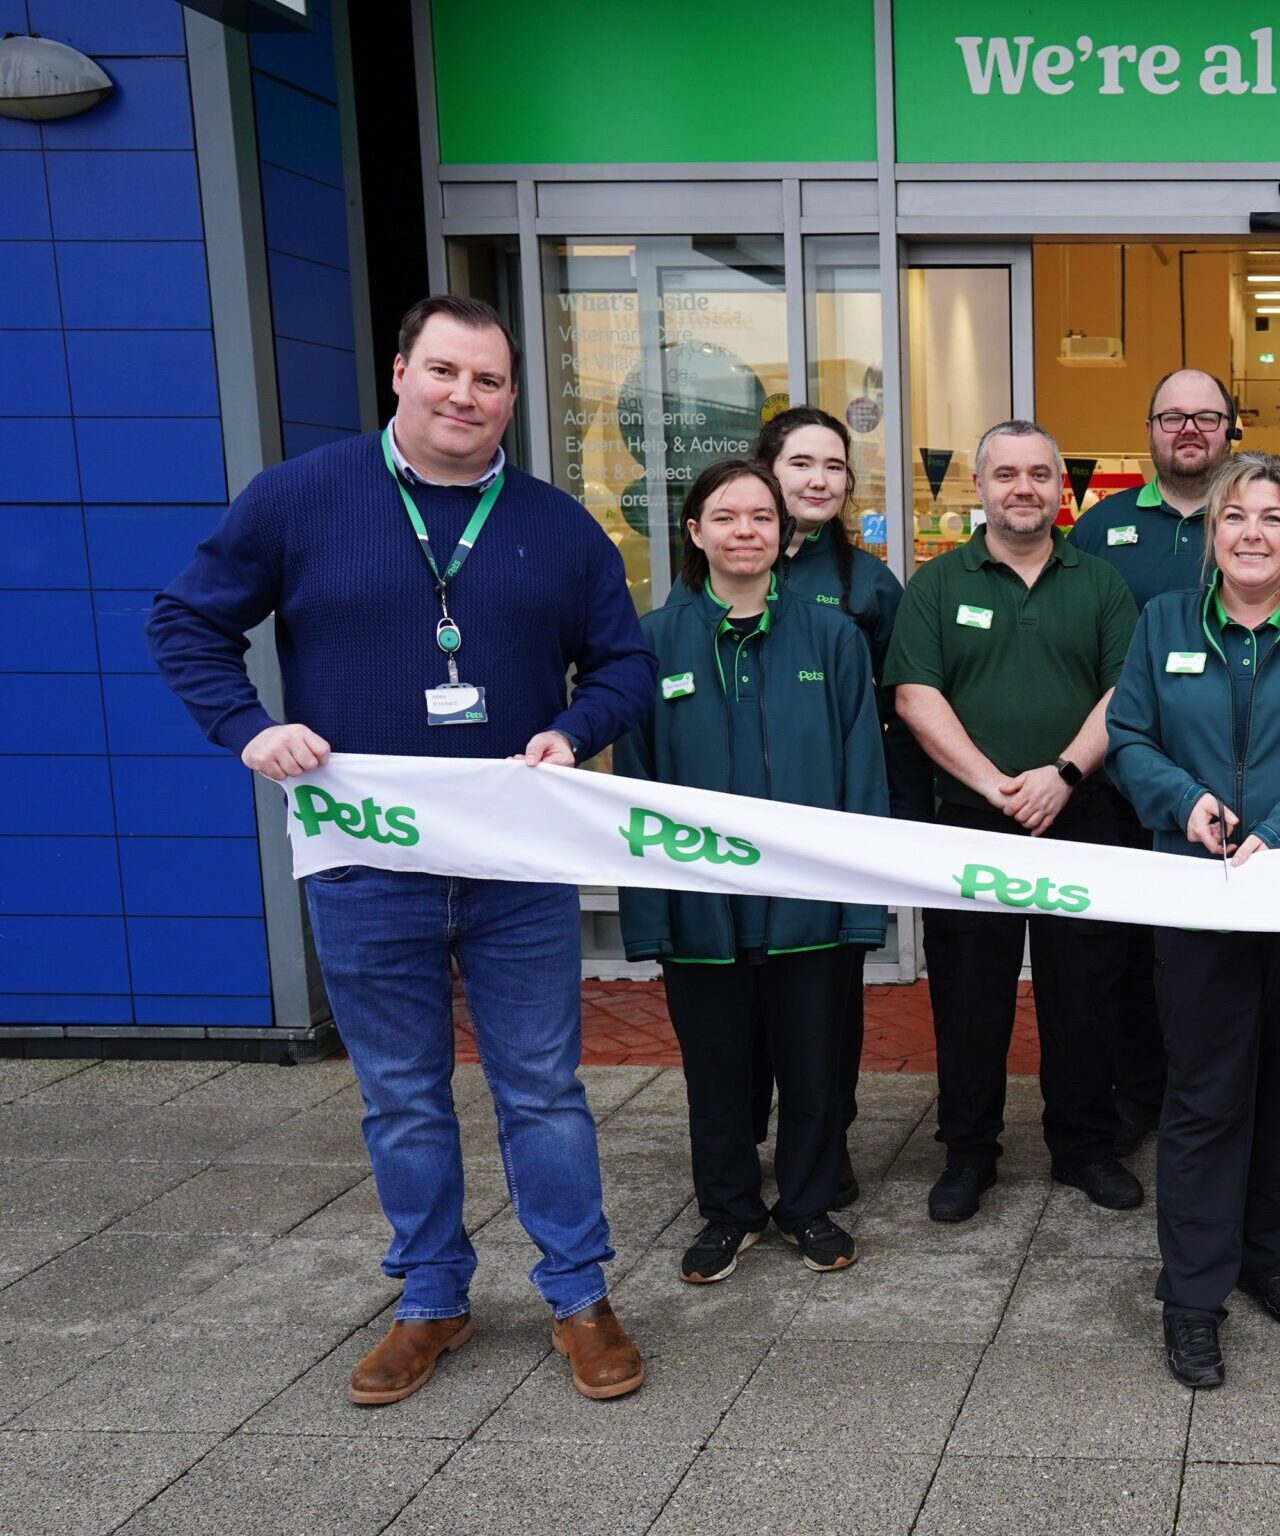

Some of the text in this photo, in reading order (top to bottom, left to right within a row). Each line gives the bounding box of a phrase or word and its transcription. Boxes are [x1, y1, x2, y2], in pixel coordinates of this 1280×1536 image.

[955, 36, 1181, 96] We're
[557, 293, 635, 312] What's
[559, 326, 652, 346] Veterinar
[649, 410, 707, 426] Centre
[628, 437, 668, 456] Help
[673, 437, 686, 453] &
[690, 437, 750, 453] Advice
[613, 464, 627, 480] &
[631, 464, 693, 480] Collect
[797, 670, 825, 681] Pets
[293, 784, 420, 847] Pets
[618, 807, 762, 866] Pets
[952, 864, 1092, 913] Pets
